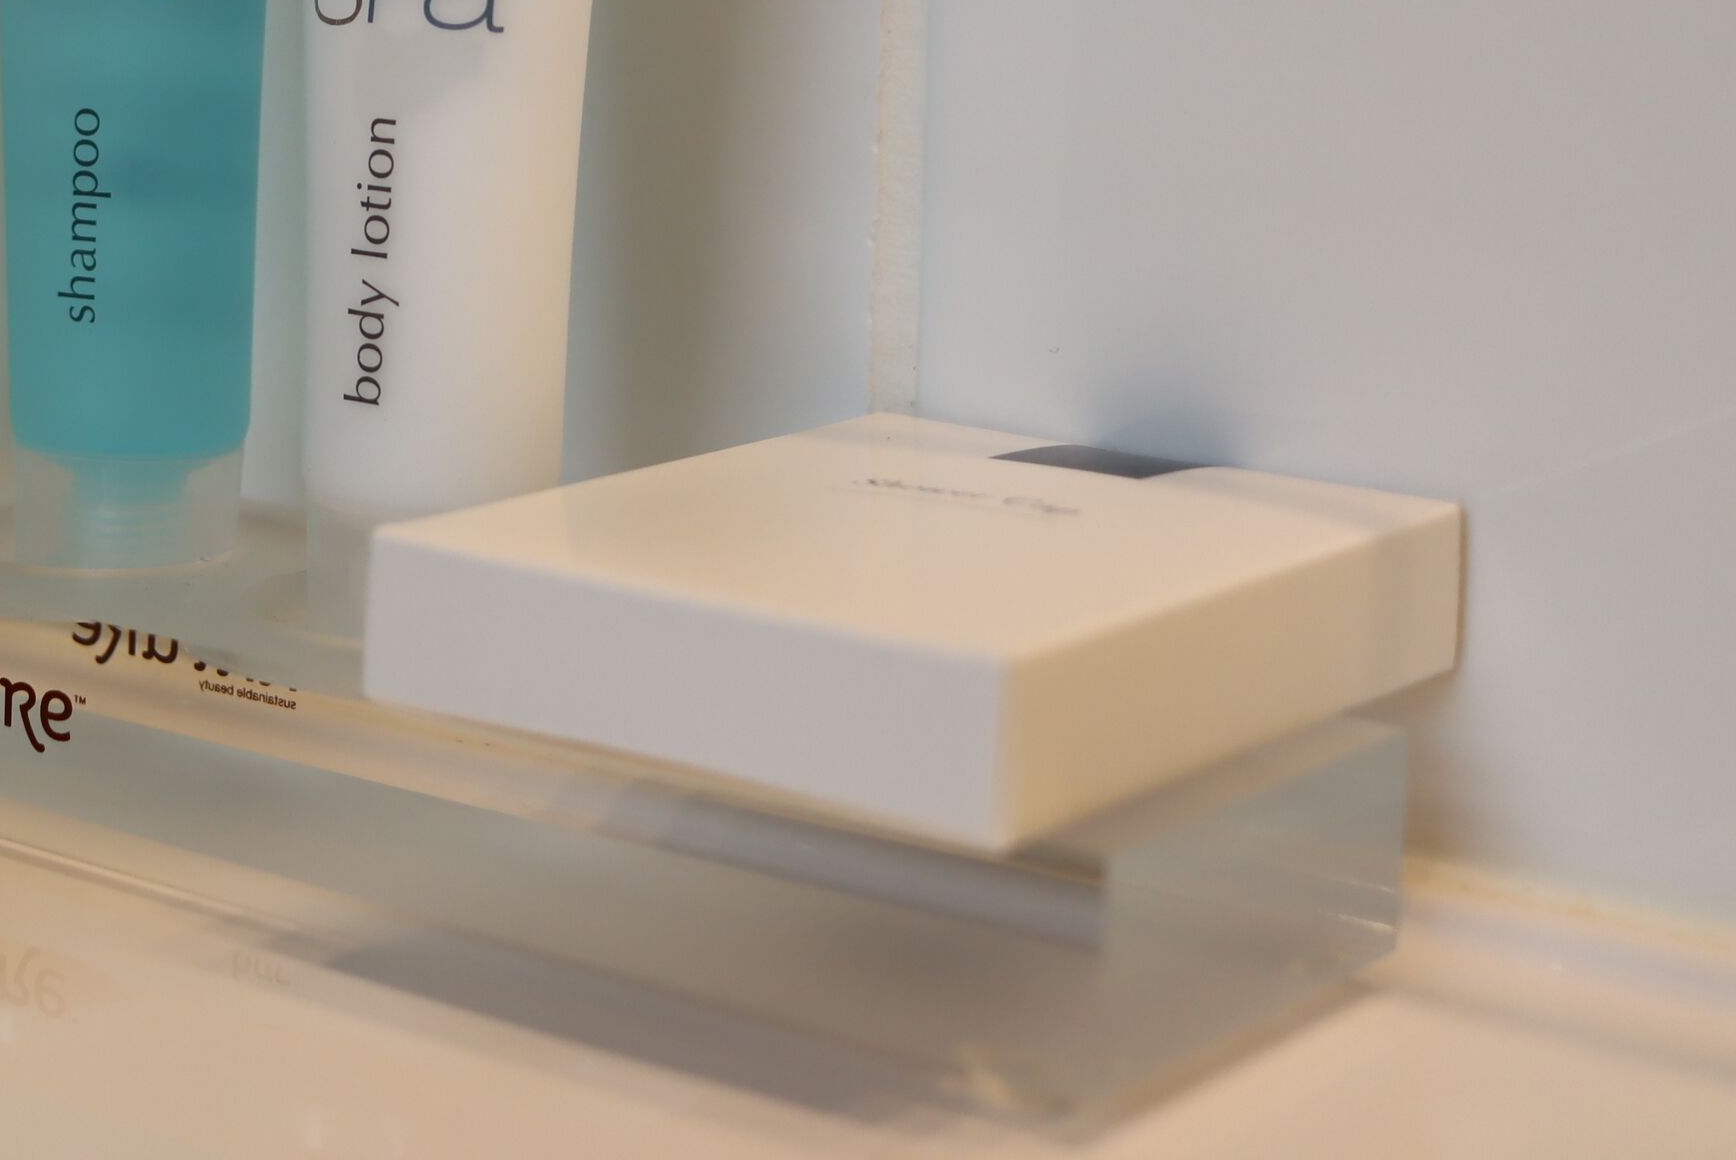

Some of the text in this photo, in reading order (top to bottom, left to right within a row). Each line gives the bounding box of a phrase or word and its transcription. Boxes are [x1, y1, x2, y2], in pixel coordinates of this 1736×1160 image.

[57, 107, 112, 325] shampoo
[343, 115, 400, 407] body lotion
